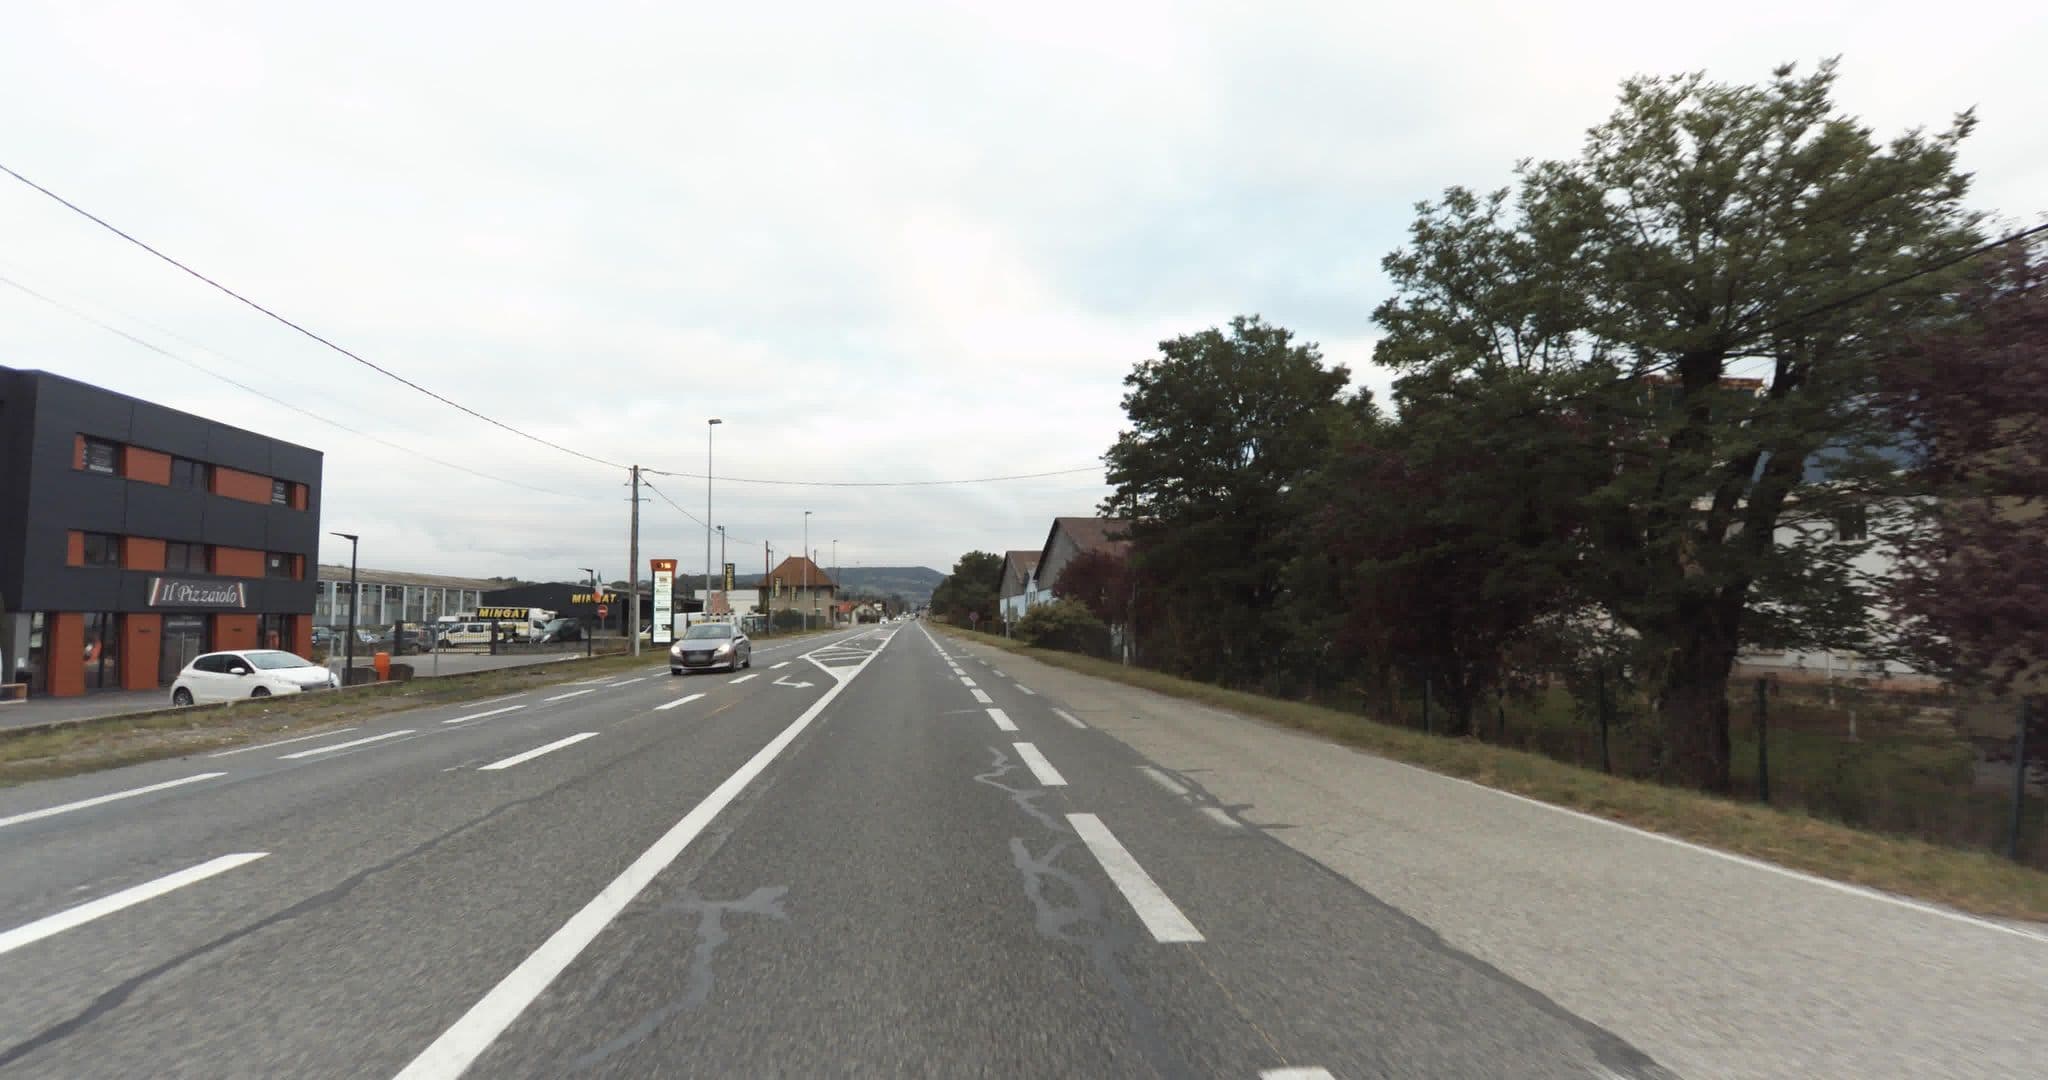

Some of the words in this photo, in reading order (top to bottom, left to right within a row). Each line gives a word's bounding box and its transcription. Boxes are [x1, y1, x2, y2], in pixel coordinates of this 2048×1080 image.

[162, 582, 178, 601] Il
[178, 584, 237, 604] Pizzaiolo
[571, 594, 617, 604] MINAT
[478, 608, 527, 618] MINGAT
